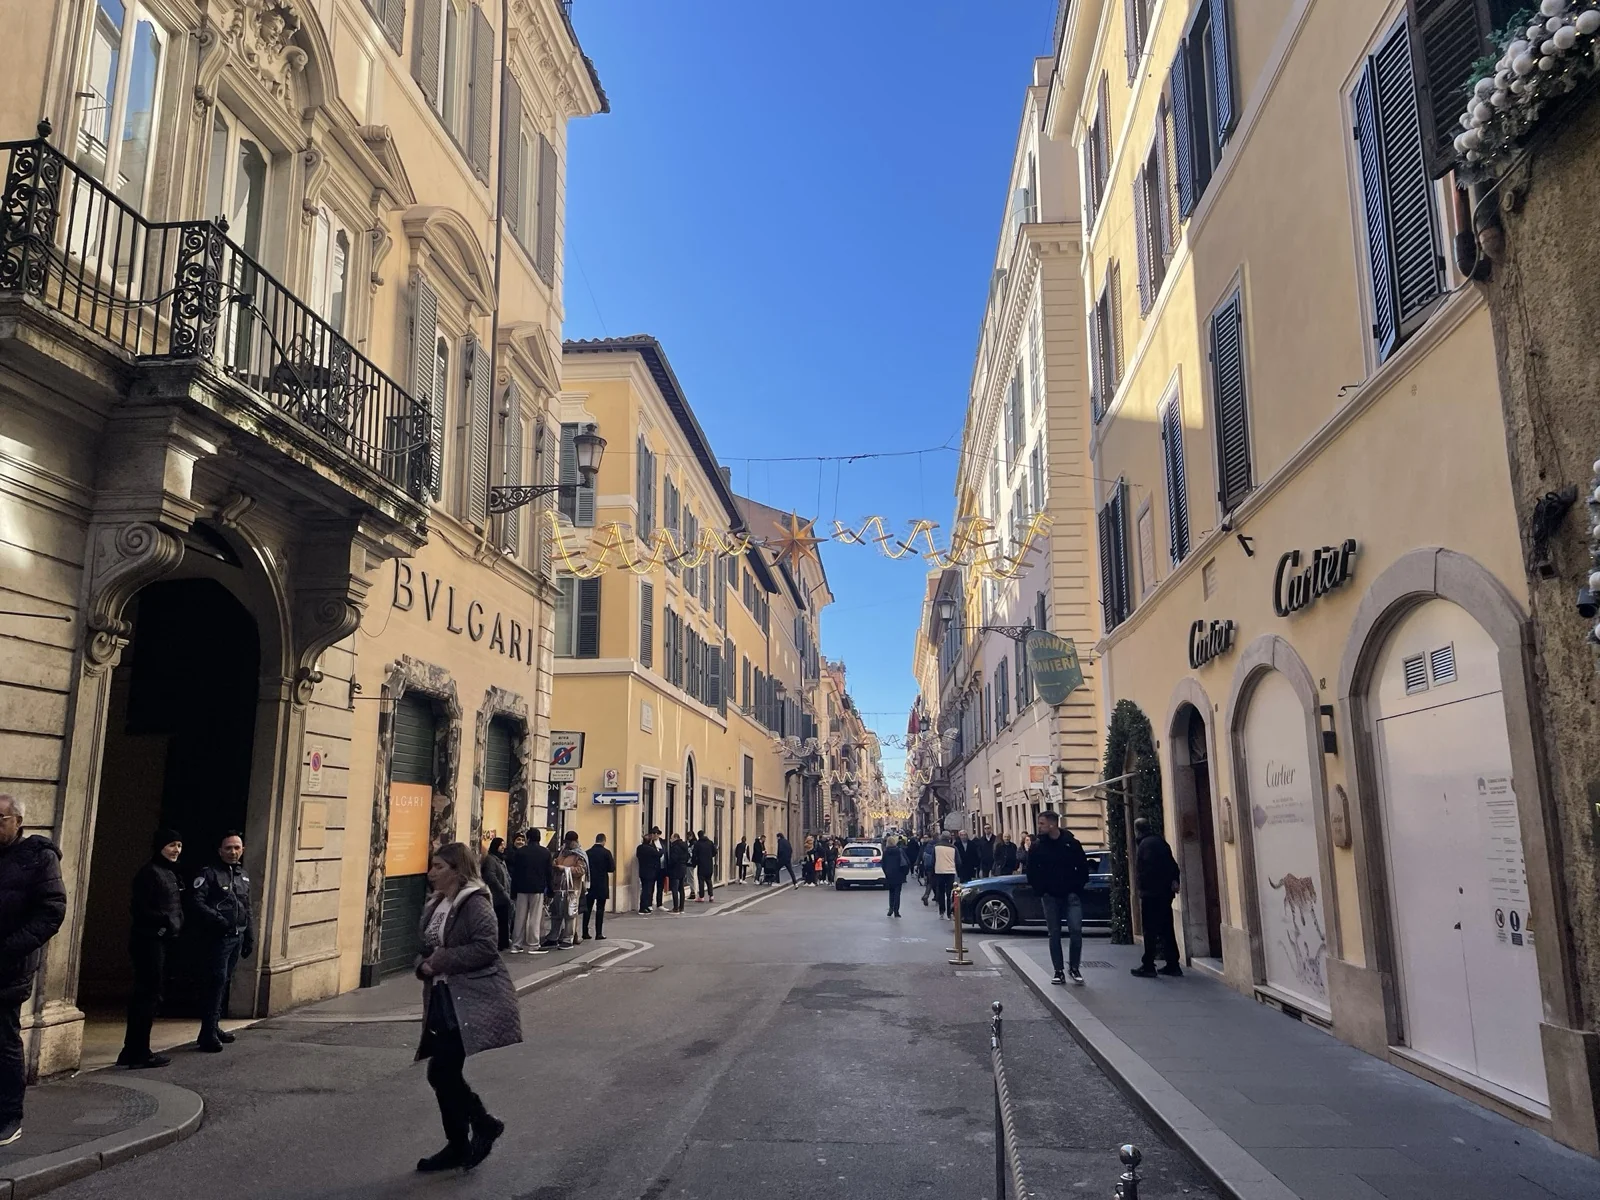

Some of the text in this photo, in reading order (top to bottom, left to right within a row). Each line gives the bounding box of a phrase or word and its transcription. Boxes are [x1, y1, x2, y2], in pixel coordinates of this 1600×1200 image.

[1272, 538, 1358, 617] Cartier
[392, 557, 533, 665] BVLGARI
[1188, 619, 1237, 670] Cartier
[1266, 759, 1296, 788] Cartier
